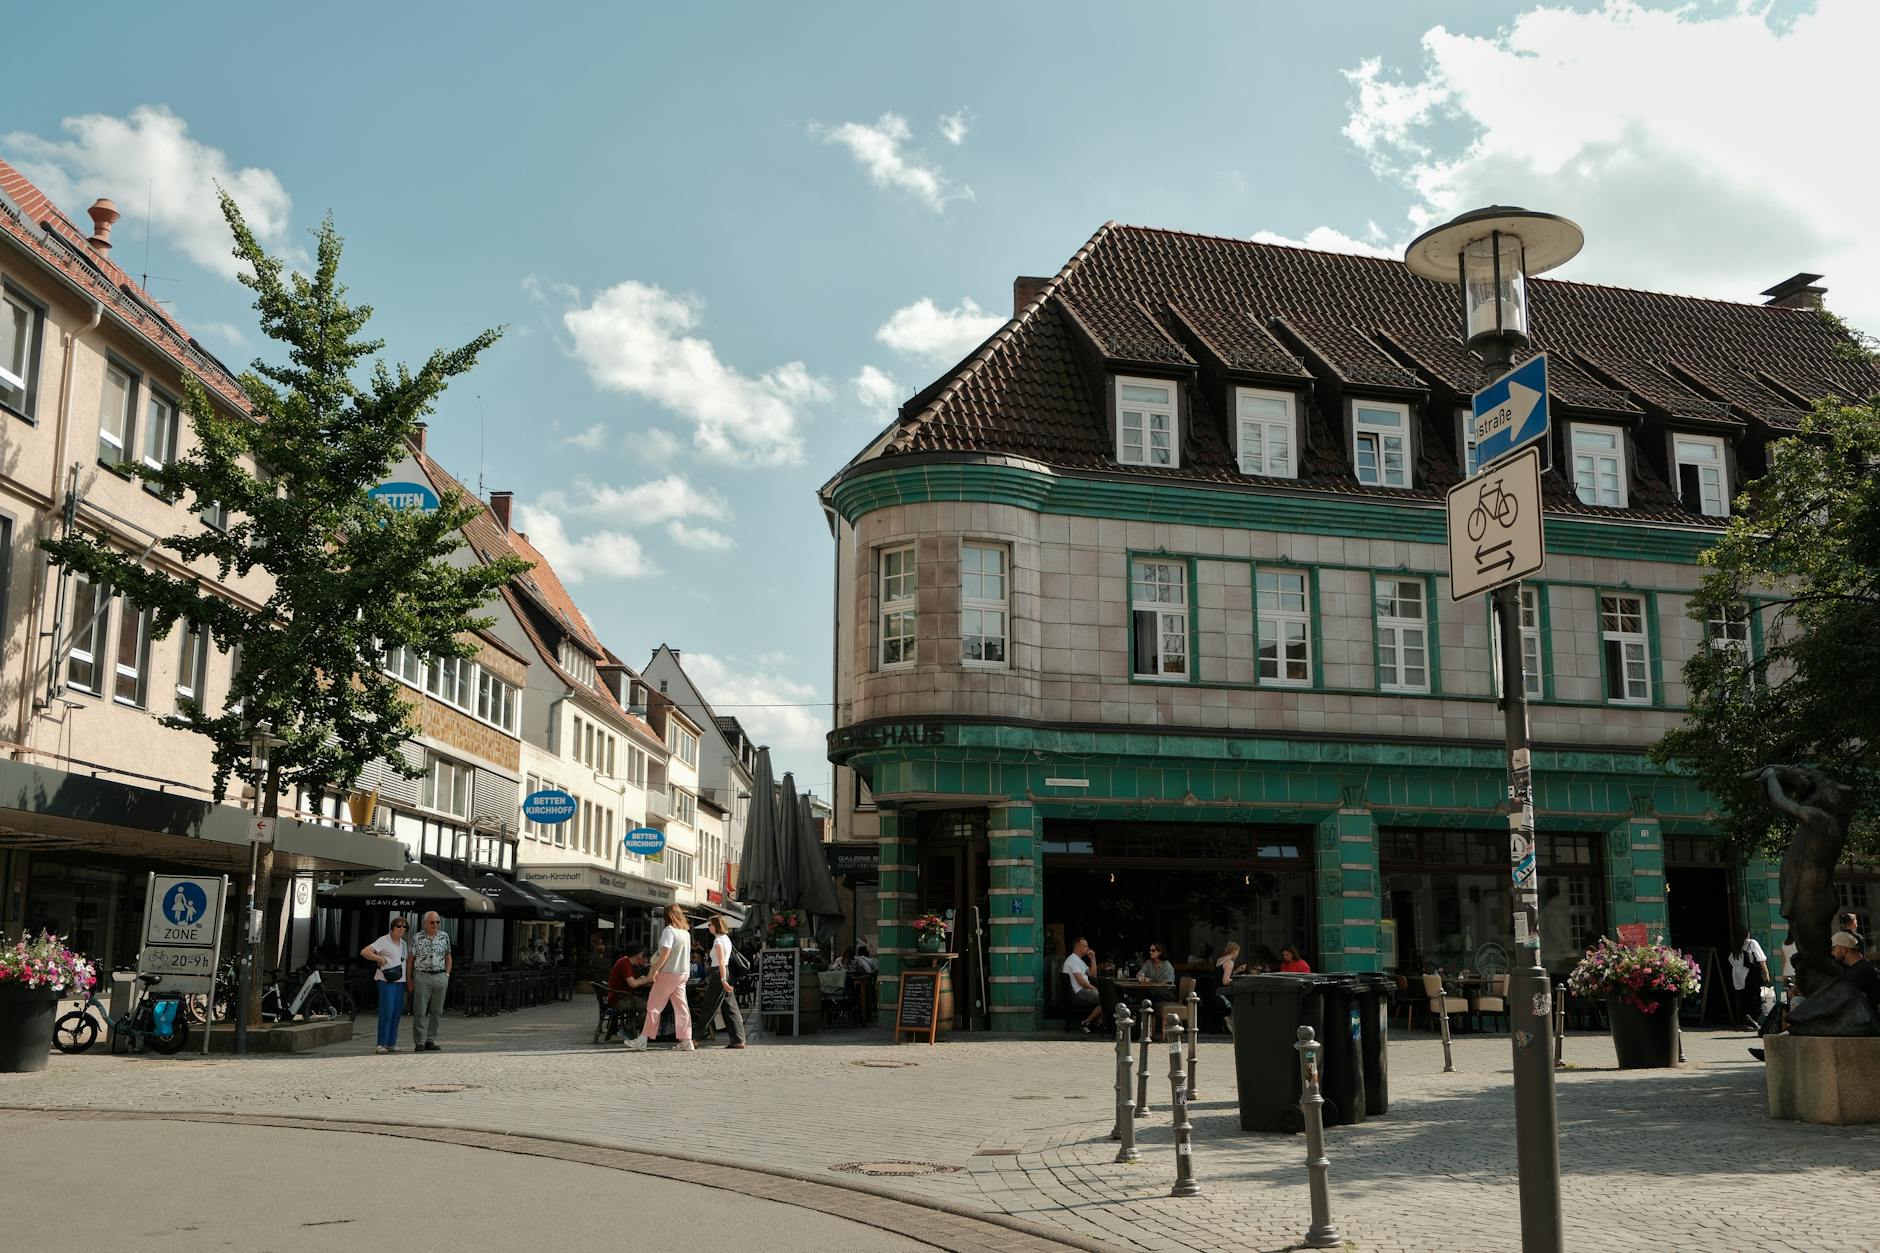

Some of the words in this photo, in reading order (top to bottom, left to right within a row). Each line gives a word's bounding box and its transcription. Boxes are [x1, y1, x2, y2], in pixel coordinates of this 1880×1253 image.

[533, 796, 566, 806] BETTEN
[525, 806, 573, 815] KIRCHHOFF
[631, 832, 658, 840] BETTEN
[625, 840, 664, 848] KIRCHHOFF
[164, 928, 198, 940] ZONE
